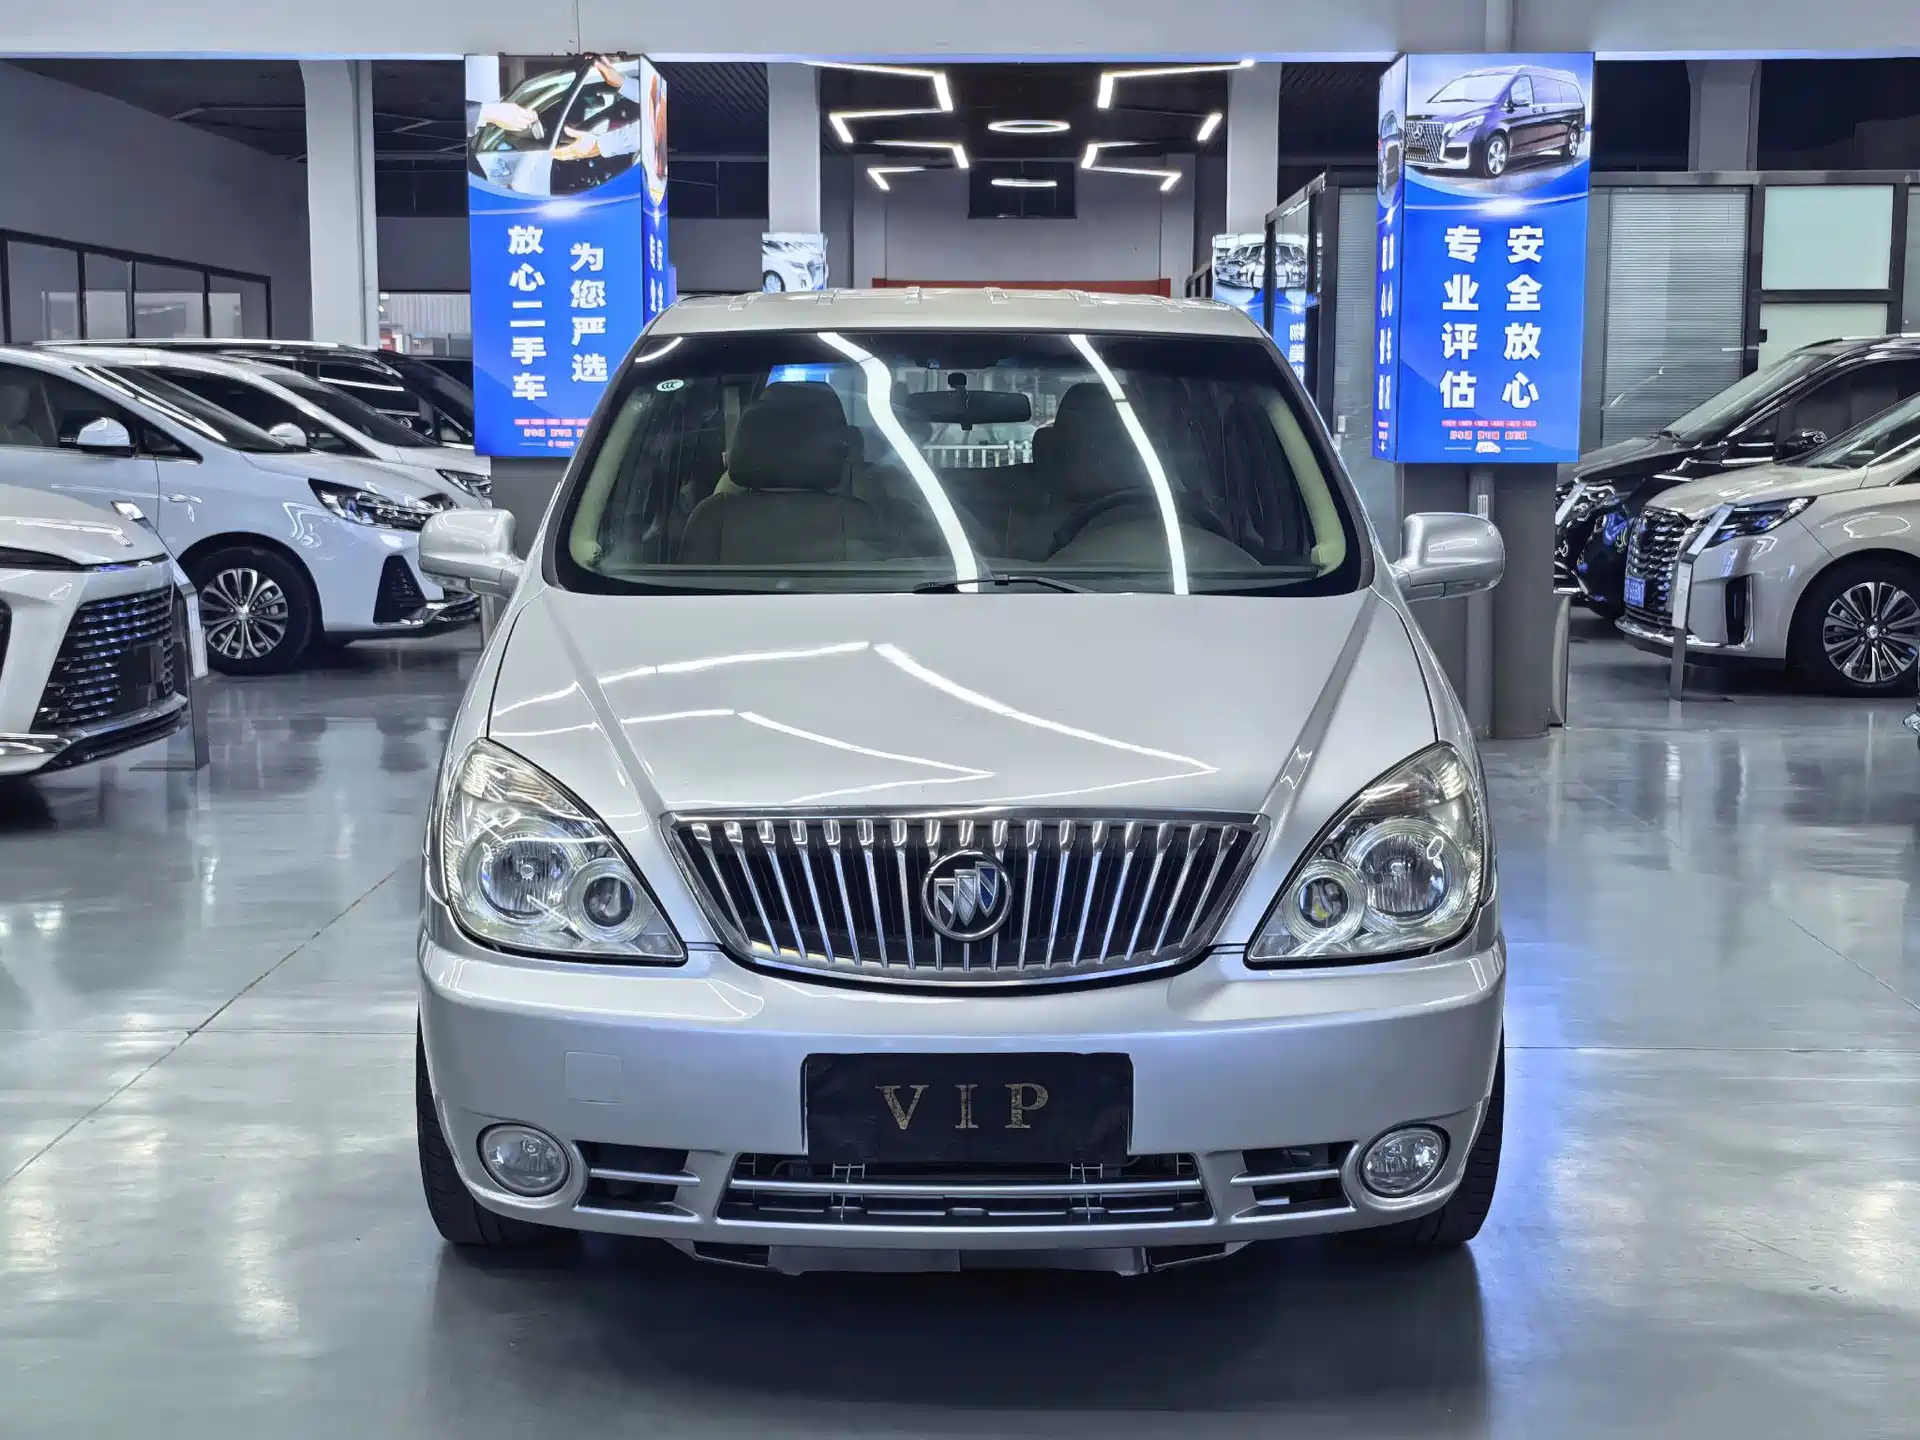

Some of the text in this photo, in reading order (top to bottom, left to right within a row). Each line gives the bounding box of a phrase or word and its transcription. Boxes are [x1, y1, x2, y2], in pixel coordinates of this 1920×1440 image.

[508, 225, 547, 401] 放心二手车
[570, 242, 608, 383] 为您严选
[1439, 225, 1482, 409] 专业评估
[1501, 225, 1545, 410] 安全放心
[875, 1083, 1049, 1130] VIP
